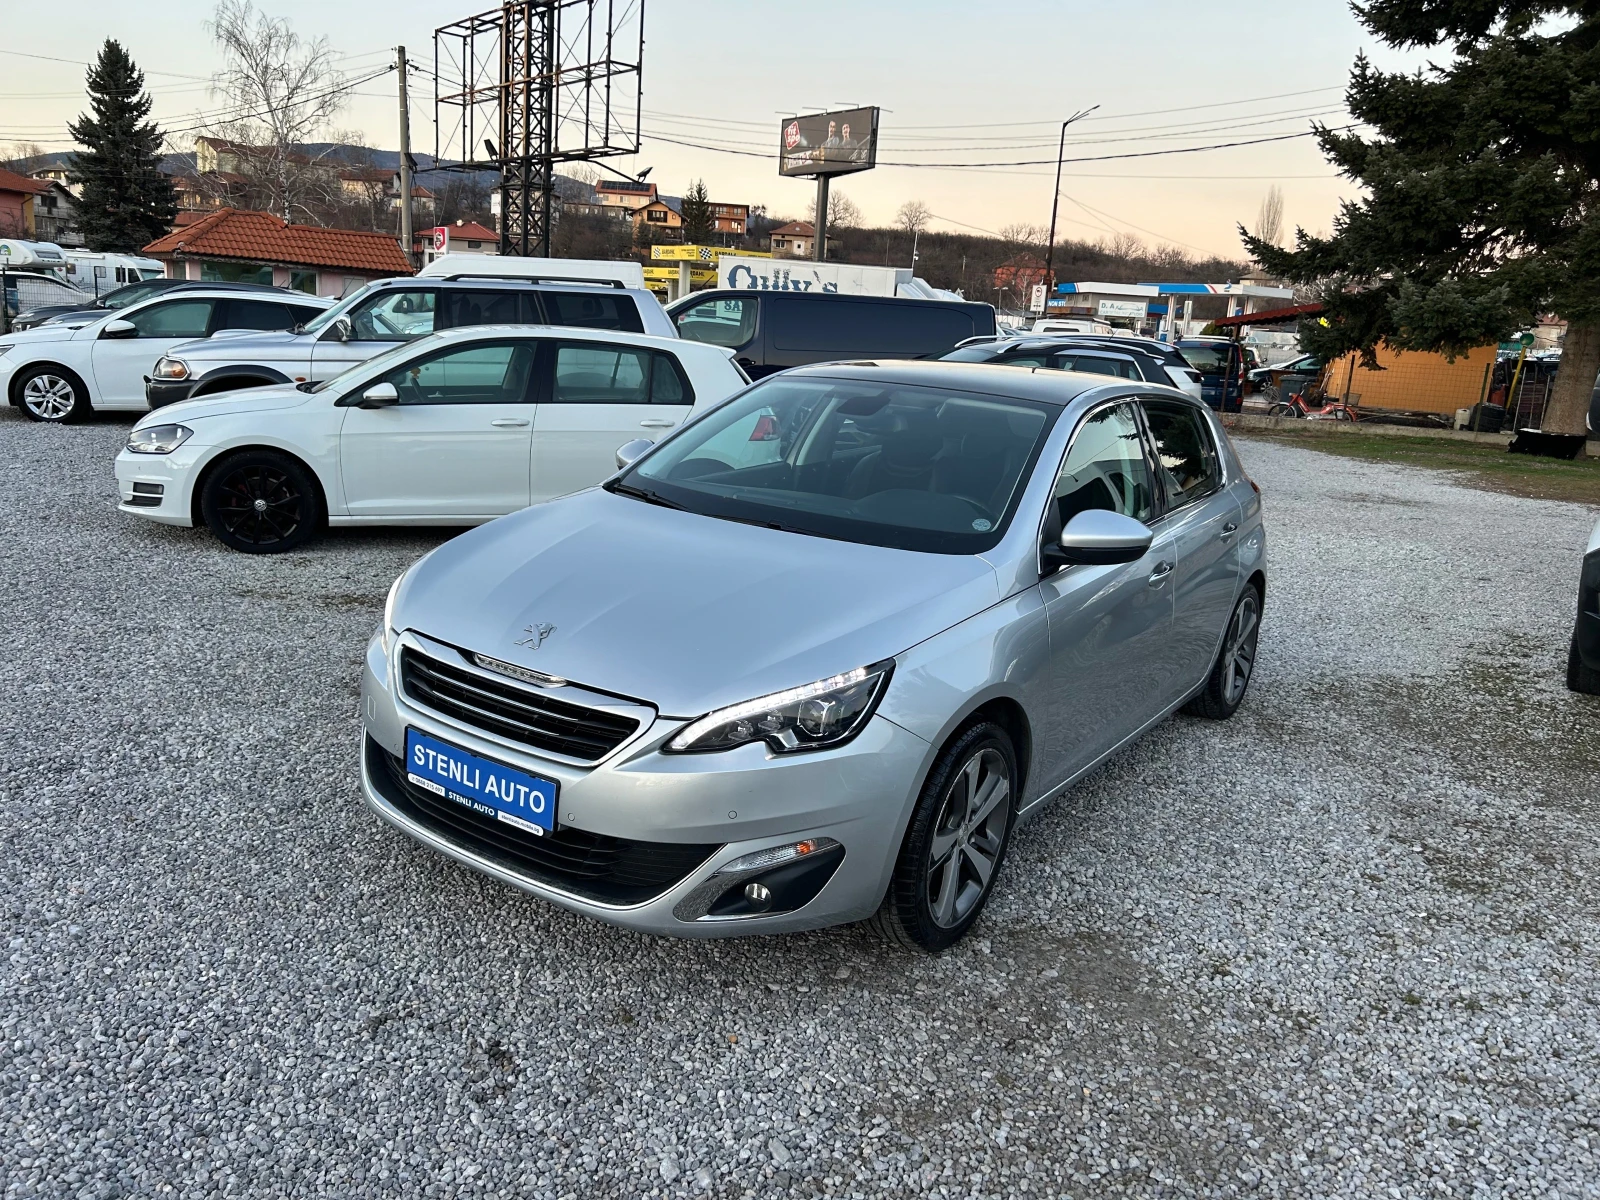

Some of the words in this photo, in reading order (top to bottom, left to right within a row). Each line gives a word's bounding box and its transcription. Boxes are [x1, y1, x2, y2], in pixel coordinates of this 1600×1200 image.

[414, 744, 480, 790] STENLI
[484, 774, 546, 814] AUTO
[448, 791, 472, 807] STENLI
[473, 802, 495, 816] AUTO
